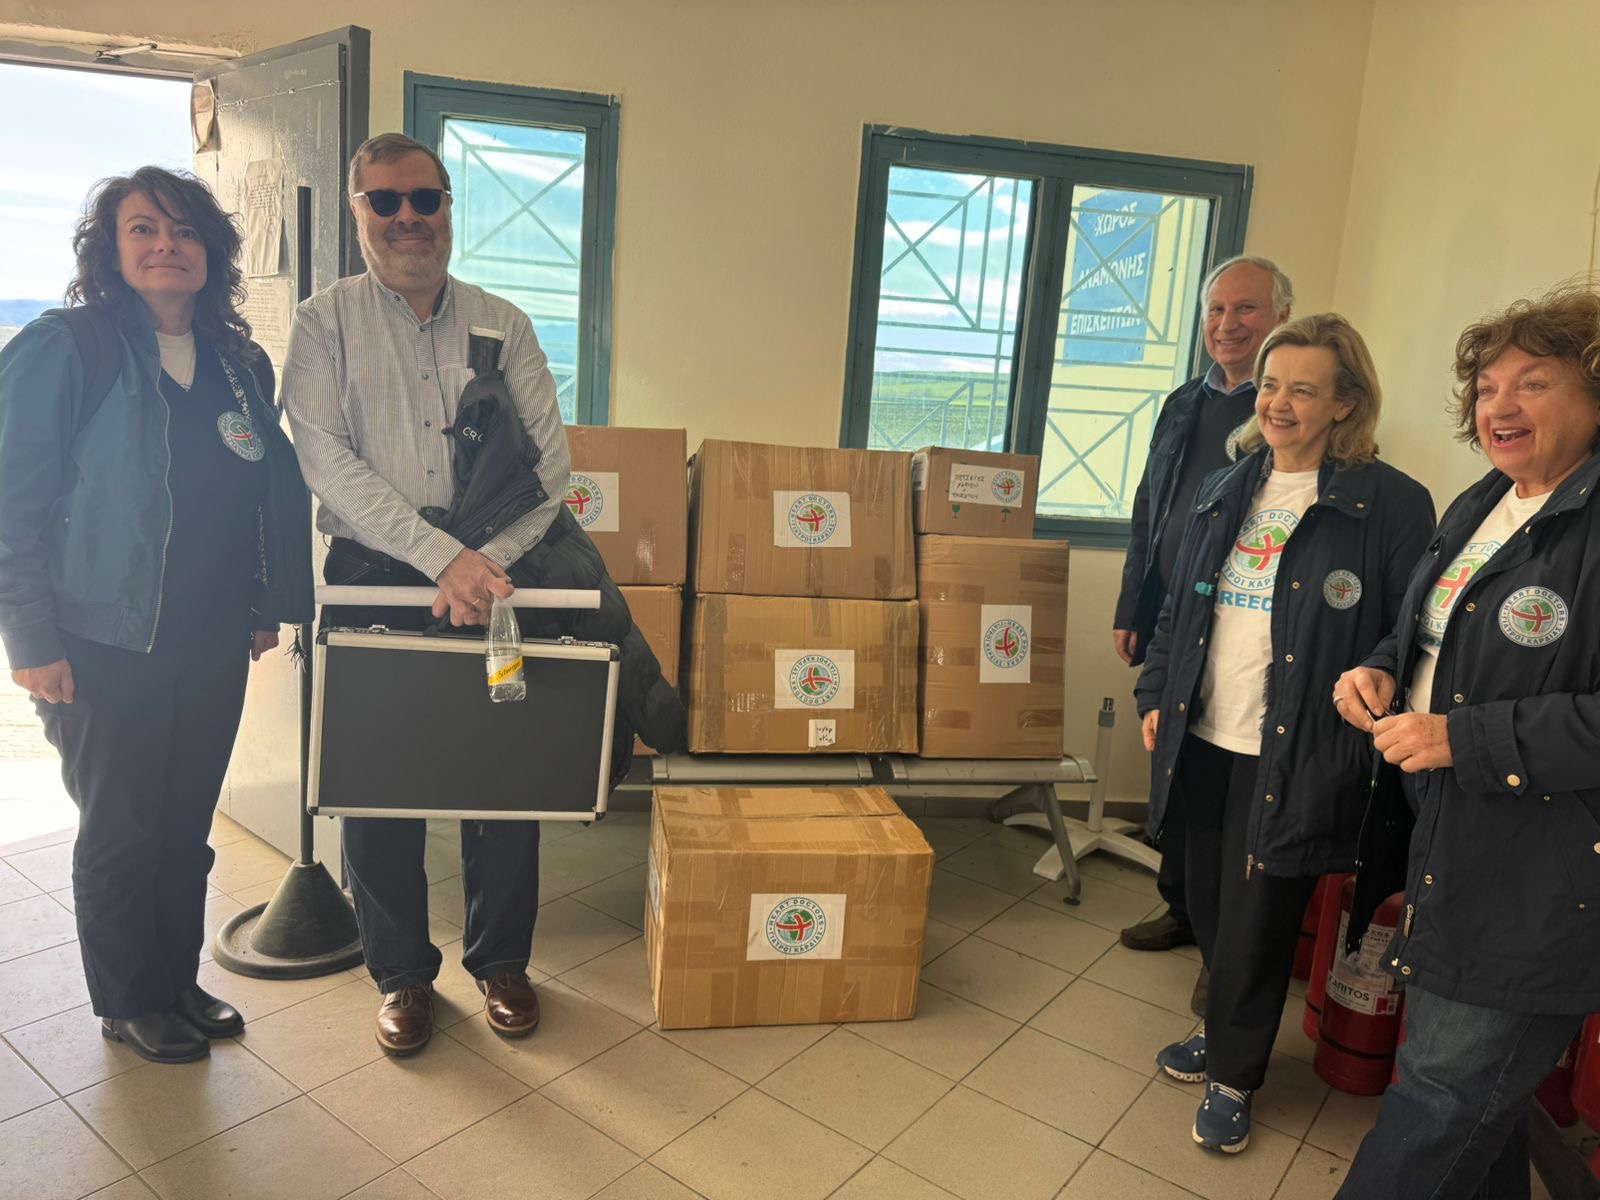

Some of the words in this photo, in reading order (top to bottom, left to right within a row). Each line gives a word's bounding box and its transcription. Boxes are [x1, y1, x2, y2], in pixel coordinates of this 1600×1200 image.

[1094, 202, 1138, 237] ΧΩΡΟΣ
[808, 496, 834, 518] DOCTORS
[1243, 514, 1264, 532] ART
[1269, 512, 1298, 527] DOCT
[1220, 590, 1273, 612] REEC
[1504, 589, 1530, 610] HEART
[1534, 589, 1565, 621] DOCTORS
[1502, 616, 1524, 642] ΓΙΑΤΡΟΙ
[1526, 627, 1561, 645] ΚΑΡΔΙΑΣ
[791, 681, 819, 704] DOCTORS
[822, 681, 838, 703] HEART
[768, 901, 790, 926] HEART
[793, 899, 824, 926] DOCTORS
[769, 931, 792, 953] ΓΙΑΤΡΟΙ
[794, 931, 823, 953] ΚΑΡΔΙΑΣ
